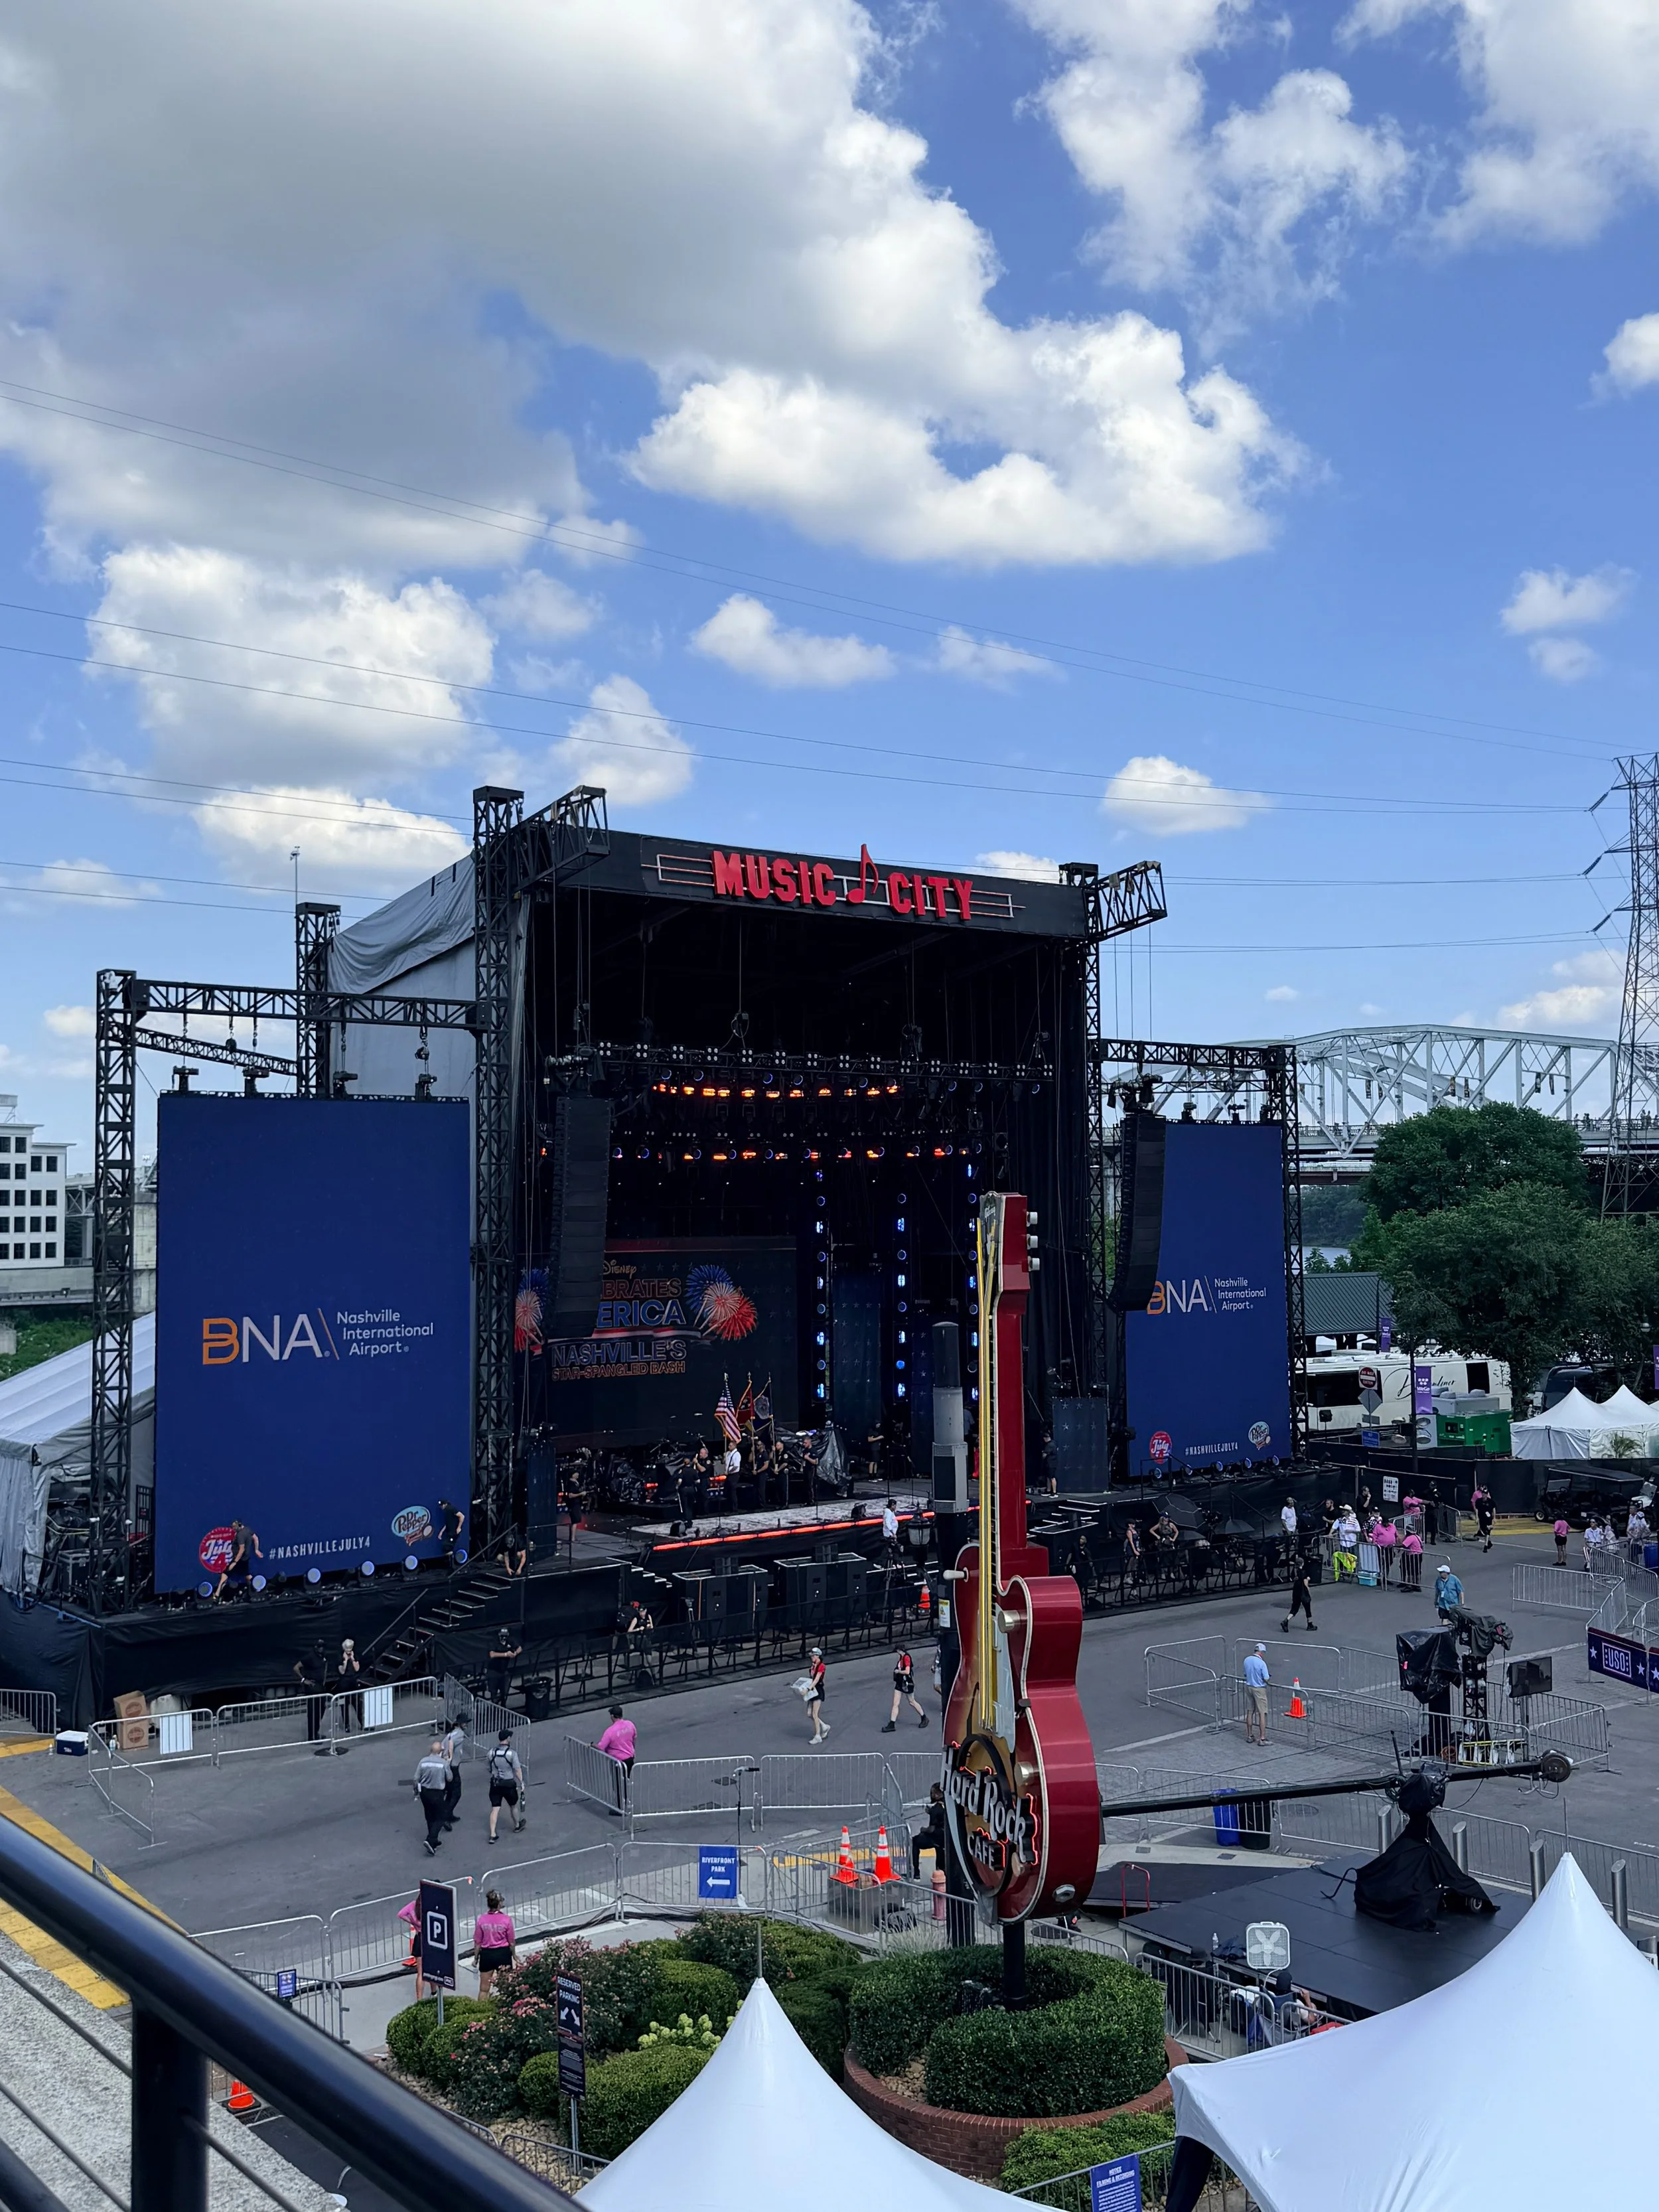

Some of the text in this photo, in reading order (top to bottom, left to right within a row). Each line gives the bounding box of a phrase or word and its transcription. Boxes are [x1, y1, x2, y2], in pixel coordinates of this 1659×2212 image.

[712, 850, 973, 921] MUSIC CITY
[601, 1278, 682, 1299] BRATES
[1214, 1277, 1248, 1288] Nashville
[1147, 1279, 1208, 1315] BNA
[1218, 1288, 1266, 1299] International
[597, 1299, 686, 1327] ERICA
[1222, 1301, 1250, 1312] Airport
[337, 1309, 400, 1324] Nashville
[202, 1313, 323, 1364] BNA
[343, 1323, 434, 1340] International
[349, 1341, 402, 1357] Airport
[552, 1339, 687, 1367] NASHVILLE'S
[552, 1361, 685, 1381] STAR-SPANGLED BASH
[1151, 1439, 1169, 1453] July
[1185, 1442, 1238, 1455] #NASHVILLEJULY4
[397, 1514, 427, 1533] Pepper
[407, 1511, 419, 1521] Dr
[269, 1536, 370, 1560] #NASHVILLEJULY4
[1609, 1648, 1625, 1672] USO
[940, 1747, 1027, 1864] Hard Rock
[968, 1834, 995, 1871] CAFE
[433, 1921, 441, 1939] P
[557, 1976, 581, 1992] RESERVED
[559, 1989, 580, 2004] PARKING
